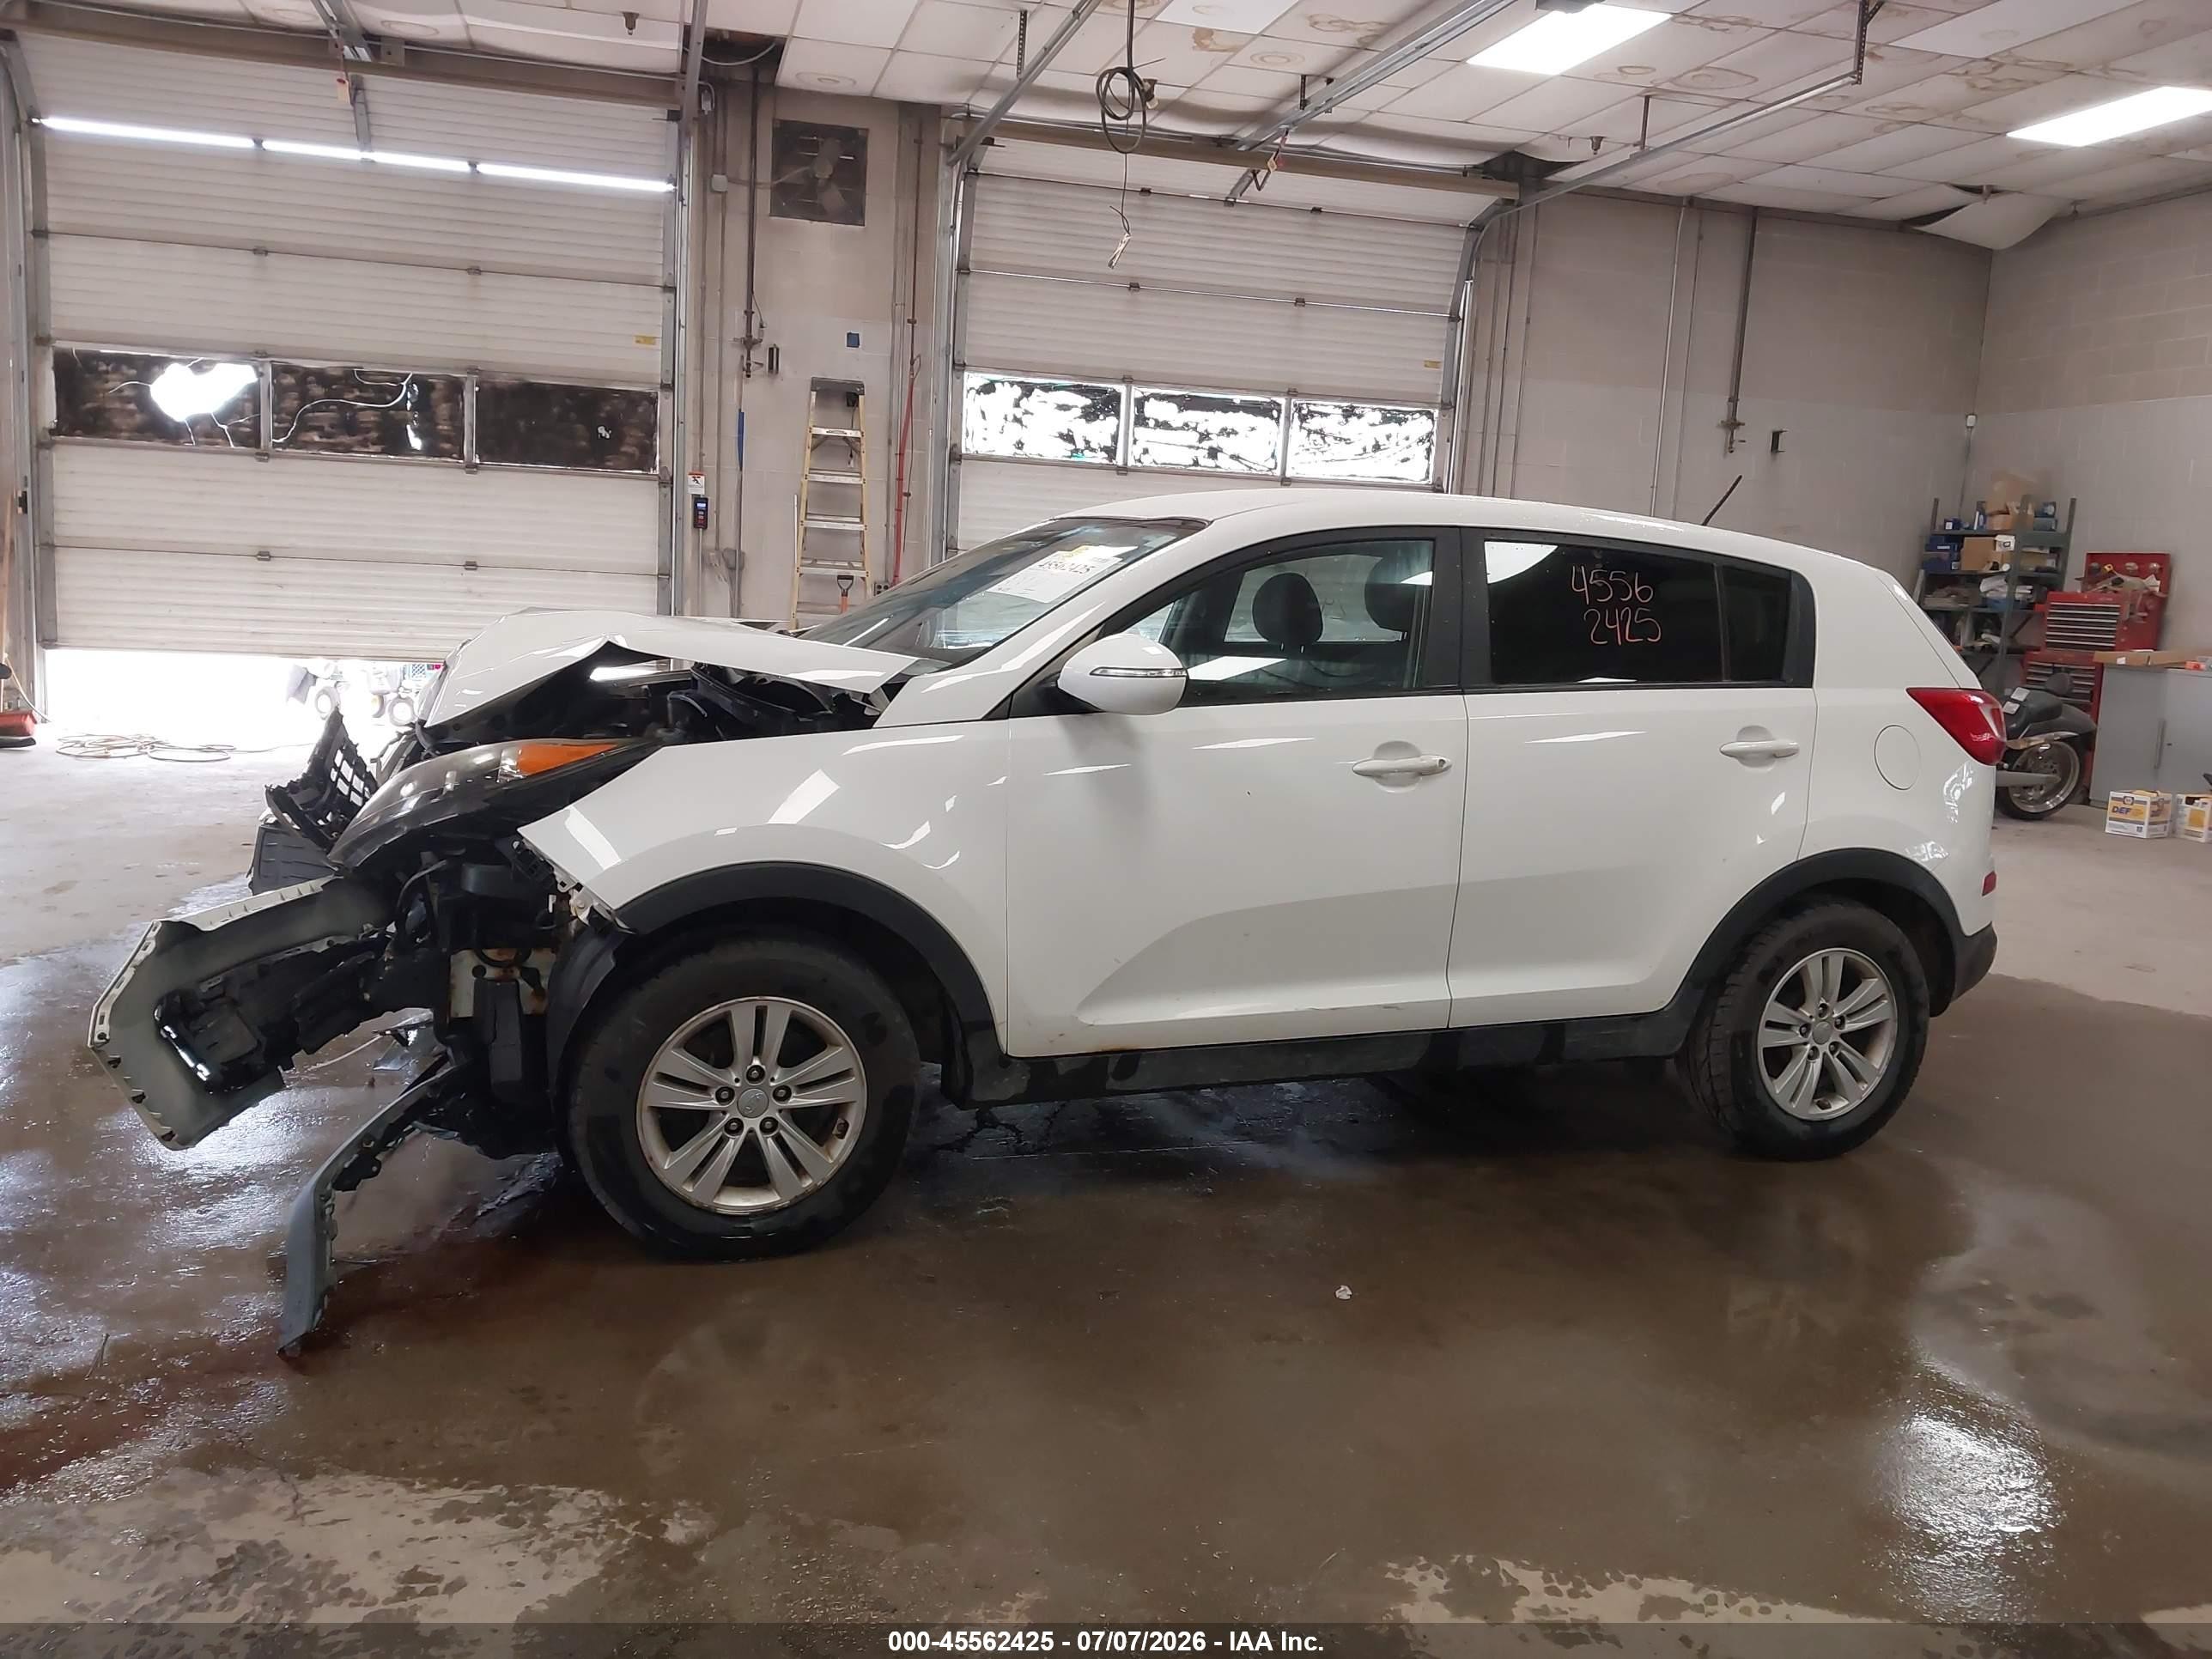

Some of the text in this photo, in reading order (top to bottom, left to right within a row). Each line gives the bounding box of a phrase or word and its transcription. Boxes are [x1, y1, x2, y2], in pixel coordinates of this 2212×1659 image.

[1571, 565, 1654, 605] 4556
[1583, 606, 1662, 646] 2425
[2112, 805, 2130, 815] DEF
